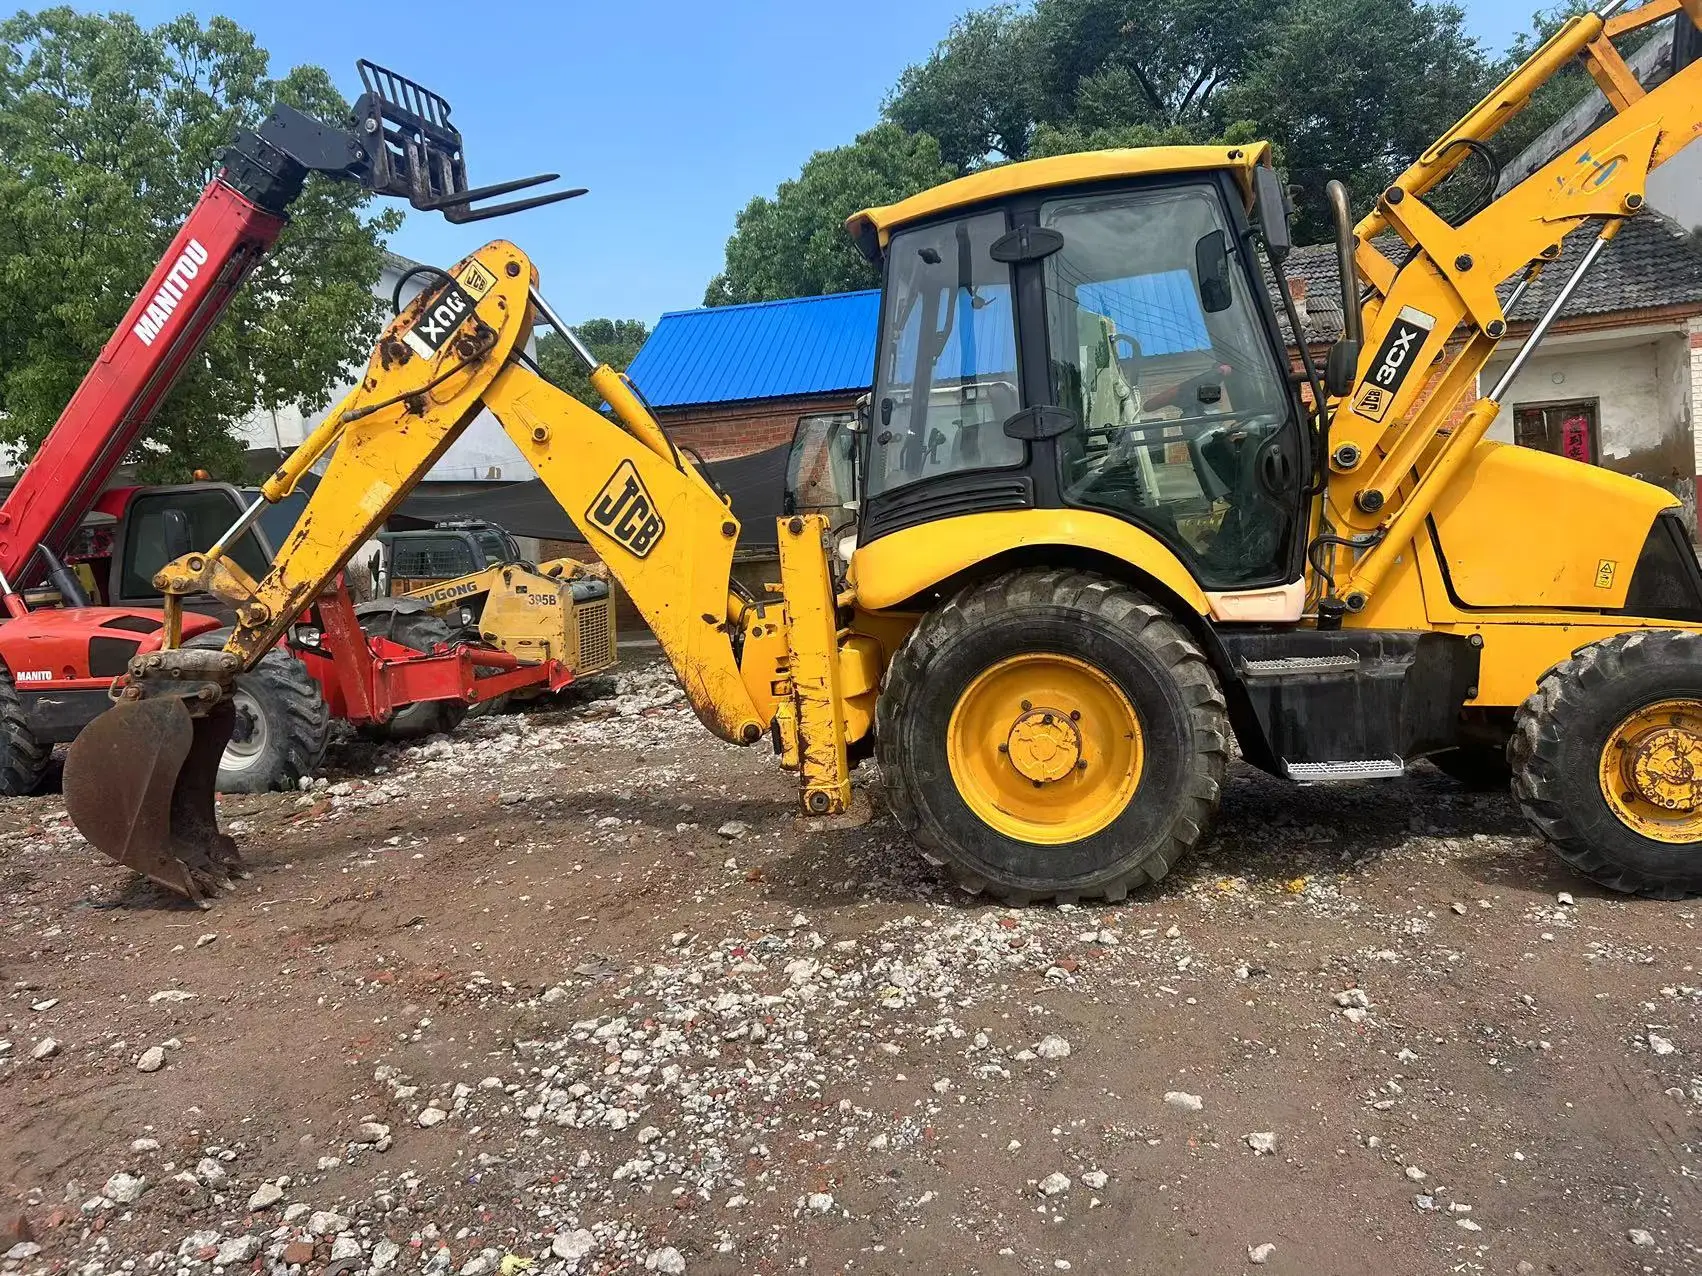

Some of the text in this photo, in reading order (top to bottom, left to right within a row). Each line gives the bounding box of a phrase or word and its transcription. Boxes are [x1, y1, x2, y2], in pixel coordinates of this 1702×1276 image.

[466, 269, 486, 291] JCB
[133, 238, 208, 346] MANITOU
[1375, 327, 1418, 385] 3CX
[1360, 390, 1382, 410] JCB
[593, 474, 663, 552] JCB
[528, 594, 557, 606] 395B
[16, 670, 53, 681] MANITO
